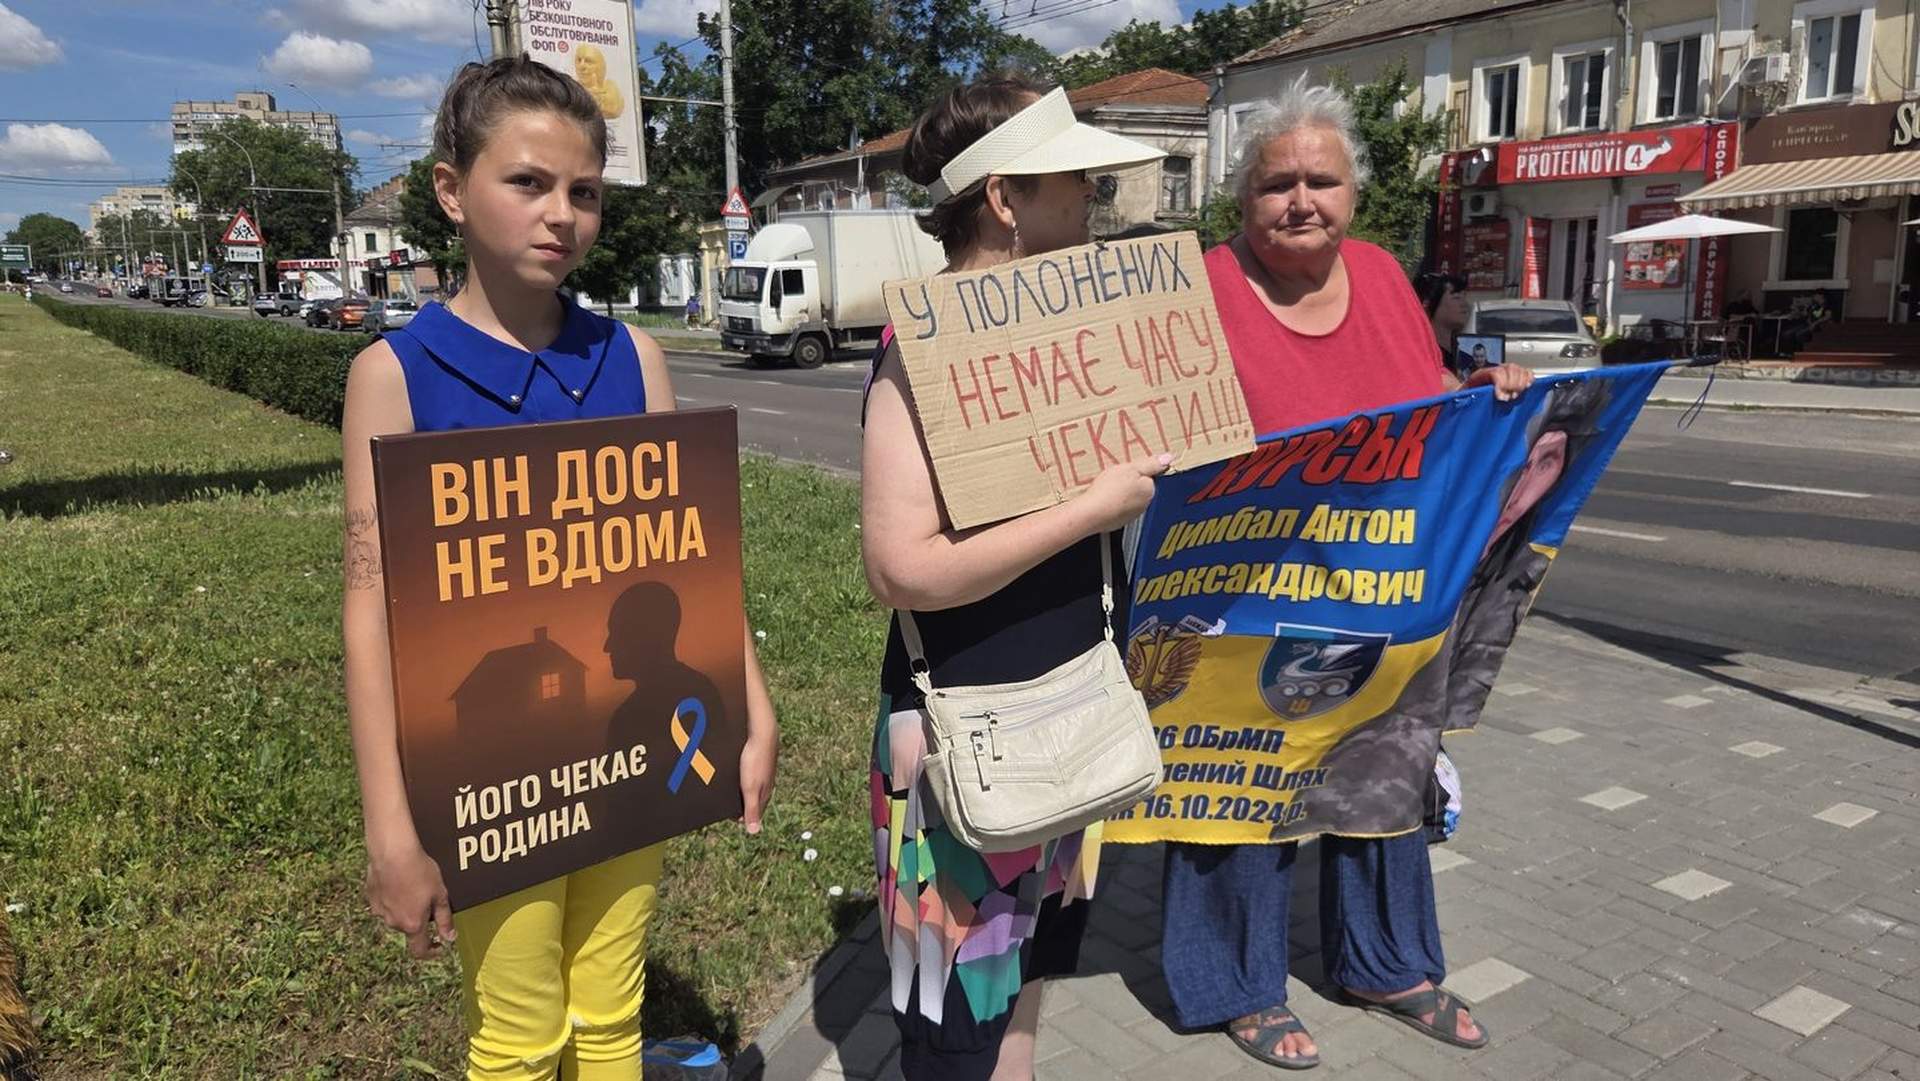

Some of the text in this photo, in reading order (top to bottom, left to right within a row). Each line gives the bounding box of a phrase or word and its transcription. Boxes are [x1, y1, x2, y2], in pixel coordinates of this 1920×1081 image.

[529, 11, 613, 32] БЕЗКОШТОВНОГО
[546, 0, 572, 11] РОКУ
[530, 25, 619, 46] ОБСЛУГОВУВАННЯ
[532, 40, 556, 52] ФОП
[1516, 146, 1643, 178] PROTEINOVI 4
[900, 240, 1192, 340] У ПОЛОНЕНИХ
[949, 307, 1219, 430] НЕМАЄ ЧАСУ
[1028, 376, 1250, 489] ЧЕКАТИ!!!
[430, 440, 680, 527] ВІН ДОСІ
[436, 506, 707, 602] НЕ ВДОМА
[1155, 503, 1416, 560] Цимбал Антон
[1182, 725, 1286, 754] ОБрМП
[454, 744, 648, 828] ЙОГО ЧЕКАЄ
[1250, 763, 1329, 792] Шлях
[457, 801, 591, 871] РОДИНА
